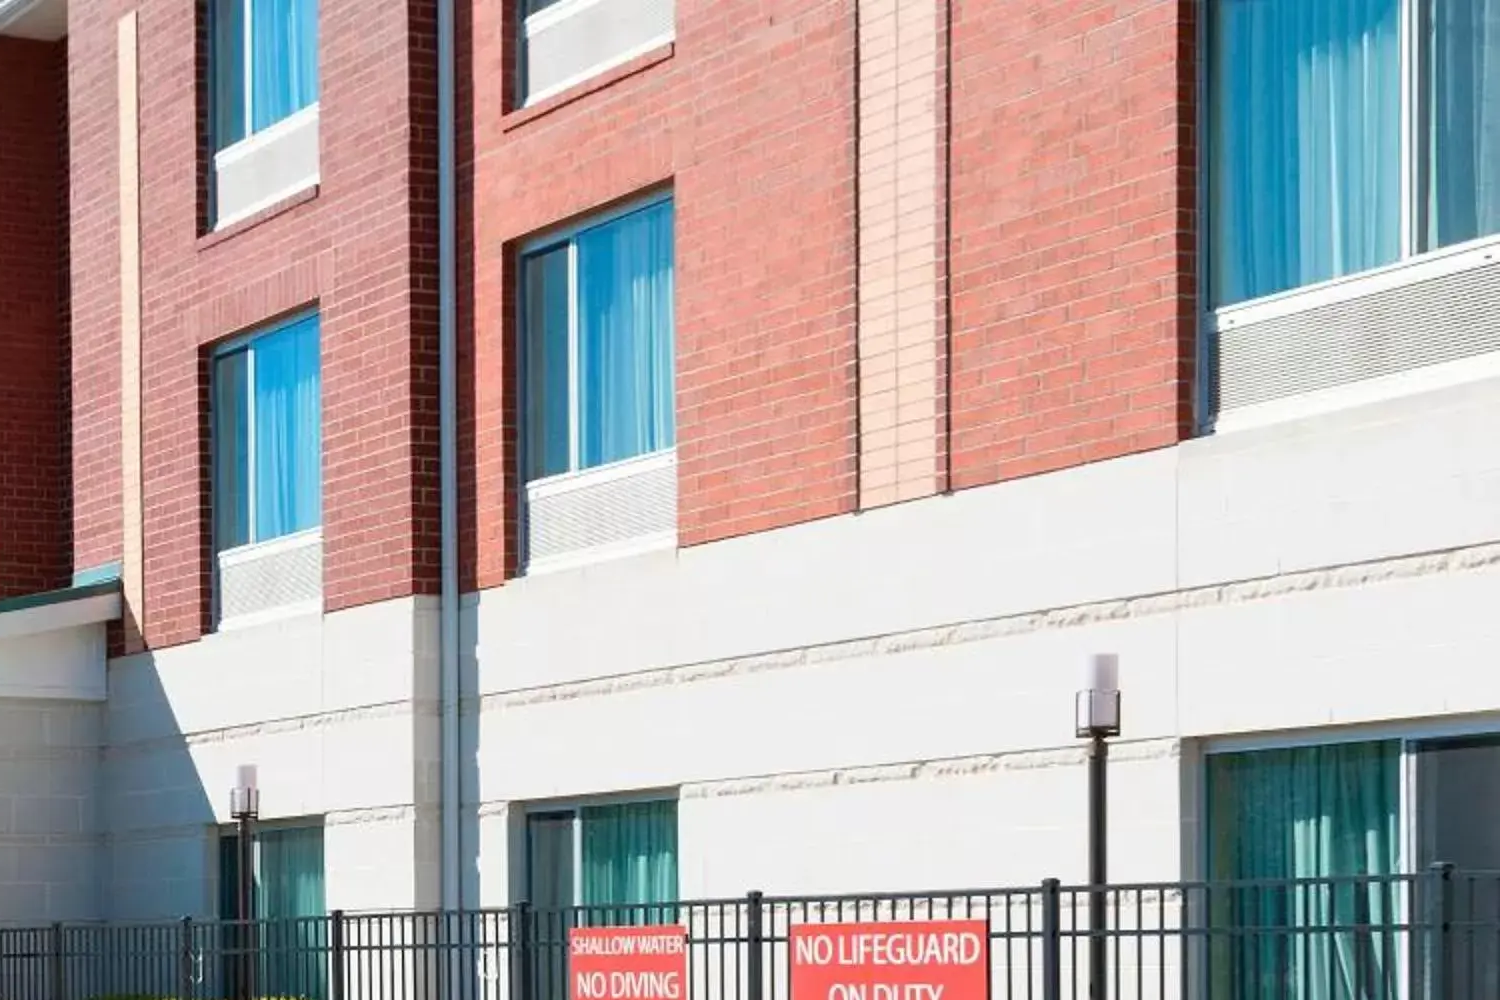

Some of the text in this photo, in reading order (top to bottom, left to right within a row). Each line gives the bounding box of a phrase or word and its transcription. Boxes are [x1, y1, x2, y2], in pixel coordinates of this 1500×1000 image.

[571, 934, 684, 955] SHALLOW WATER
[796, 932, 981, 965] NO LIFEGUARD
[577, 971, 679, 999] NO DIVING
